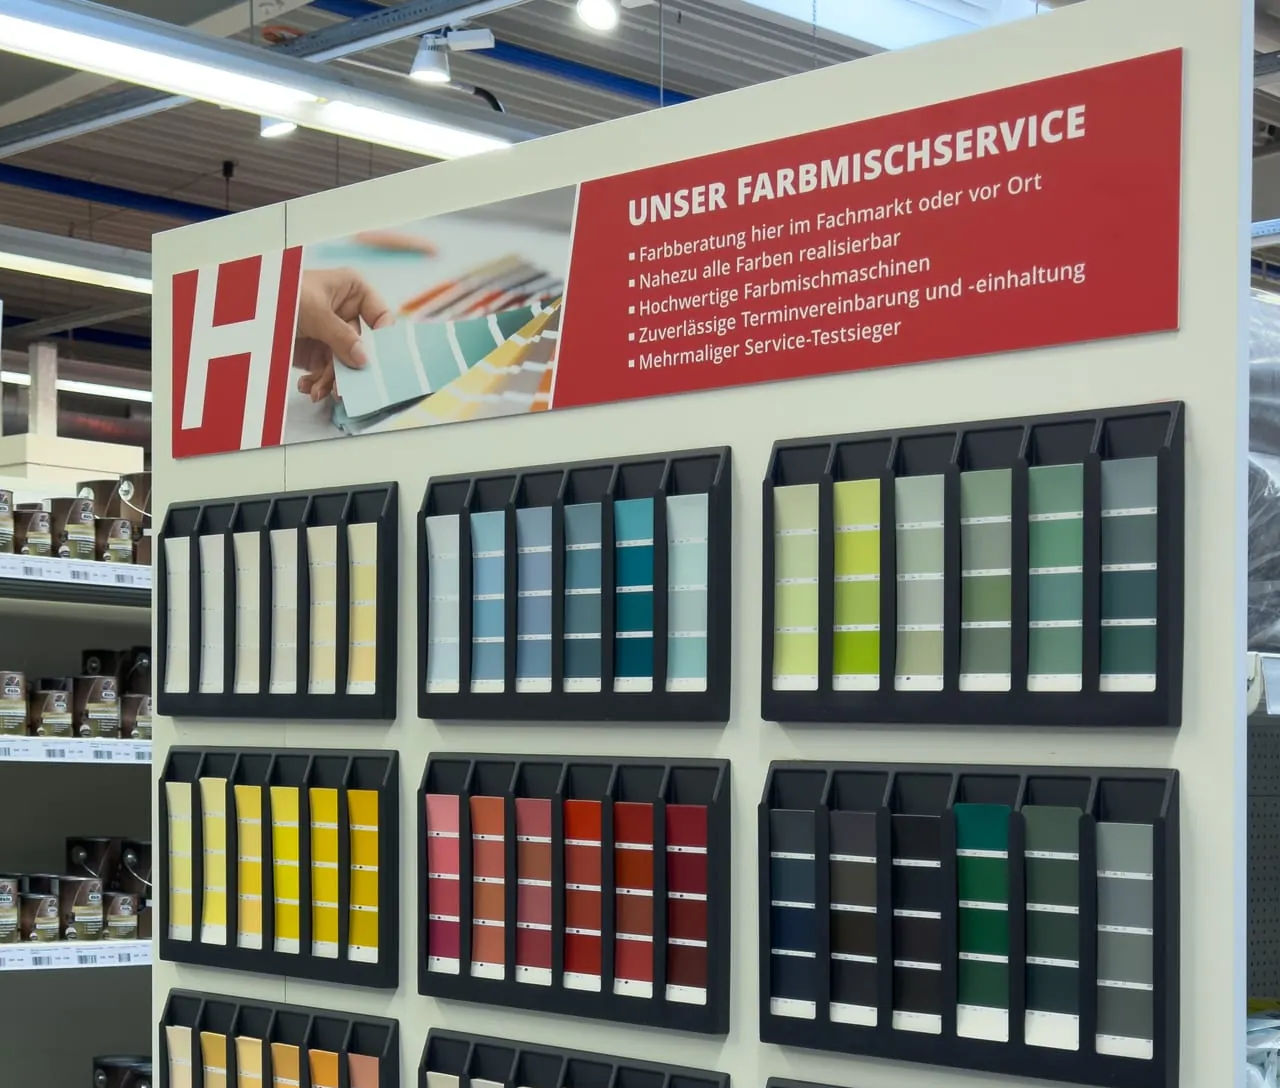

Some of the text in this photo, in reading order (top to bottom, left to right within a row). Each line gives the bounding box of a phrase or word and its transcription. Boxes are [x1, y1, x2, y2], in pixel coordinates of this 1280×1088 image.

[628, 104, 1087, 226] UNSER FARBMISCHSERVICE
[639, 172, 1043, 262] Farbberatung hier im Fachmarkt oder vor Ort
[639, 229, 902, 290] Nahezu alle Farben realisierbar
[639, 255, 930, 317] Hochwertige Farbmischmaschinen
[638, 260, 1087, 343] Zuverlässige Terminvereinbarung und -einhaltung
[639, 320, 902, 371] Mehrmaliger Service-Testsieger
